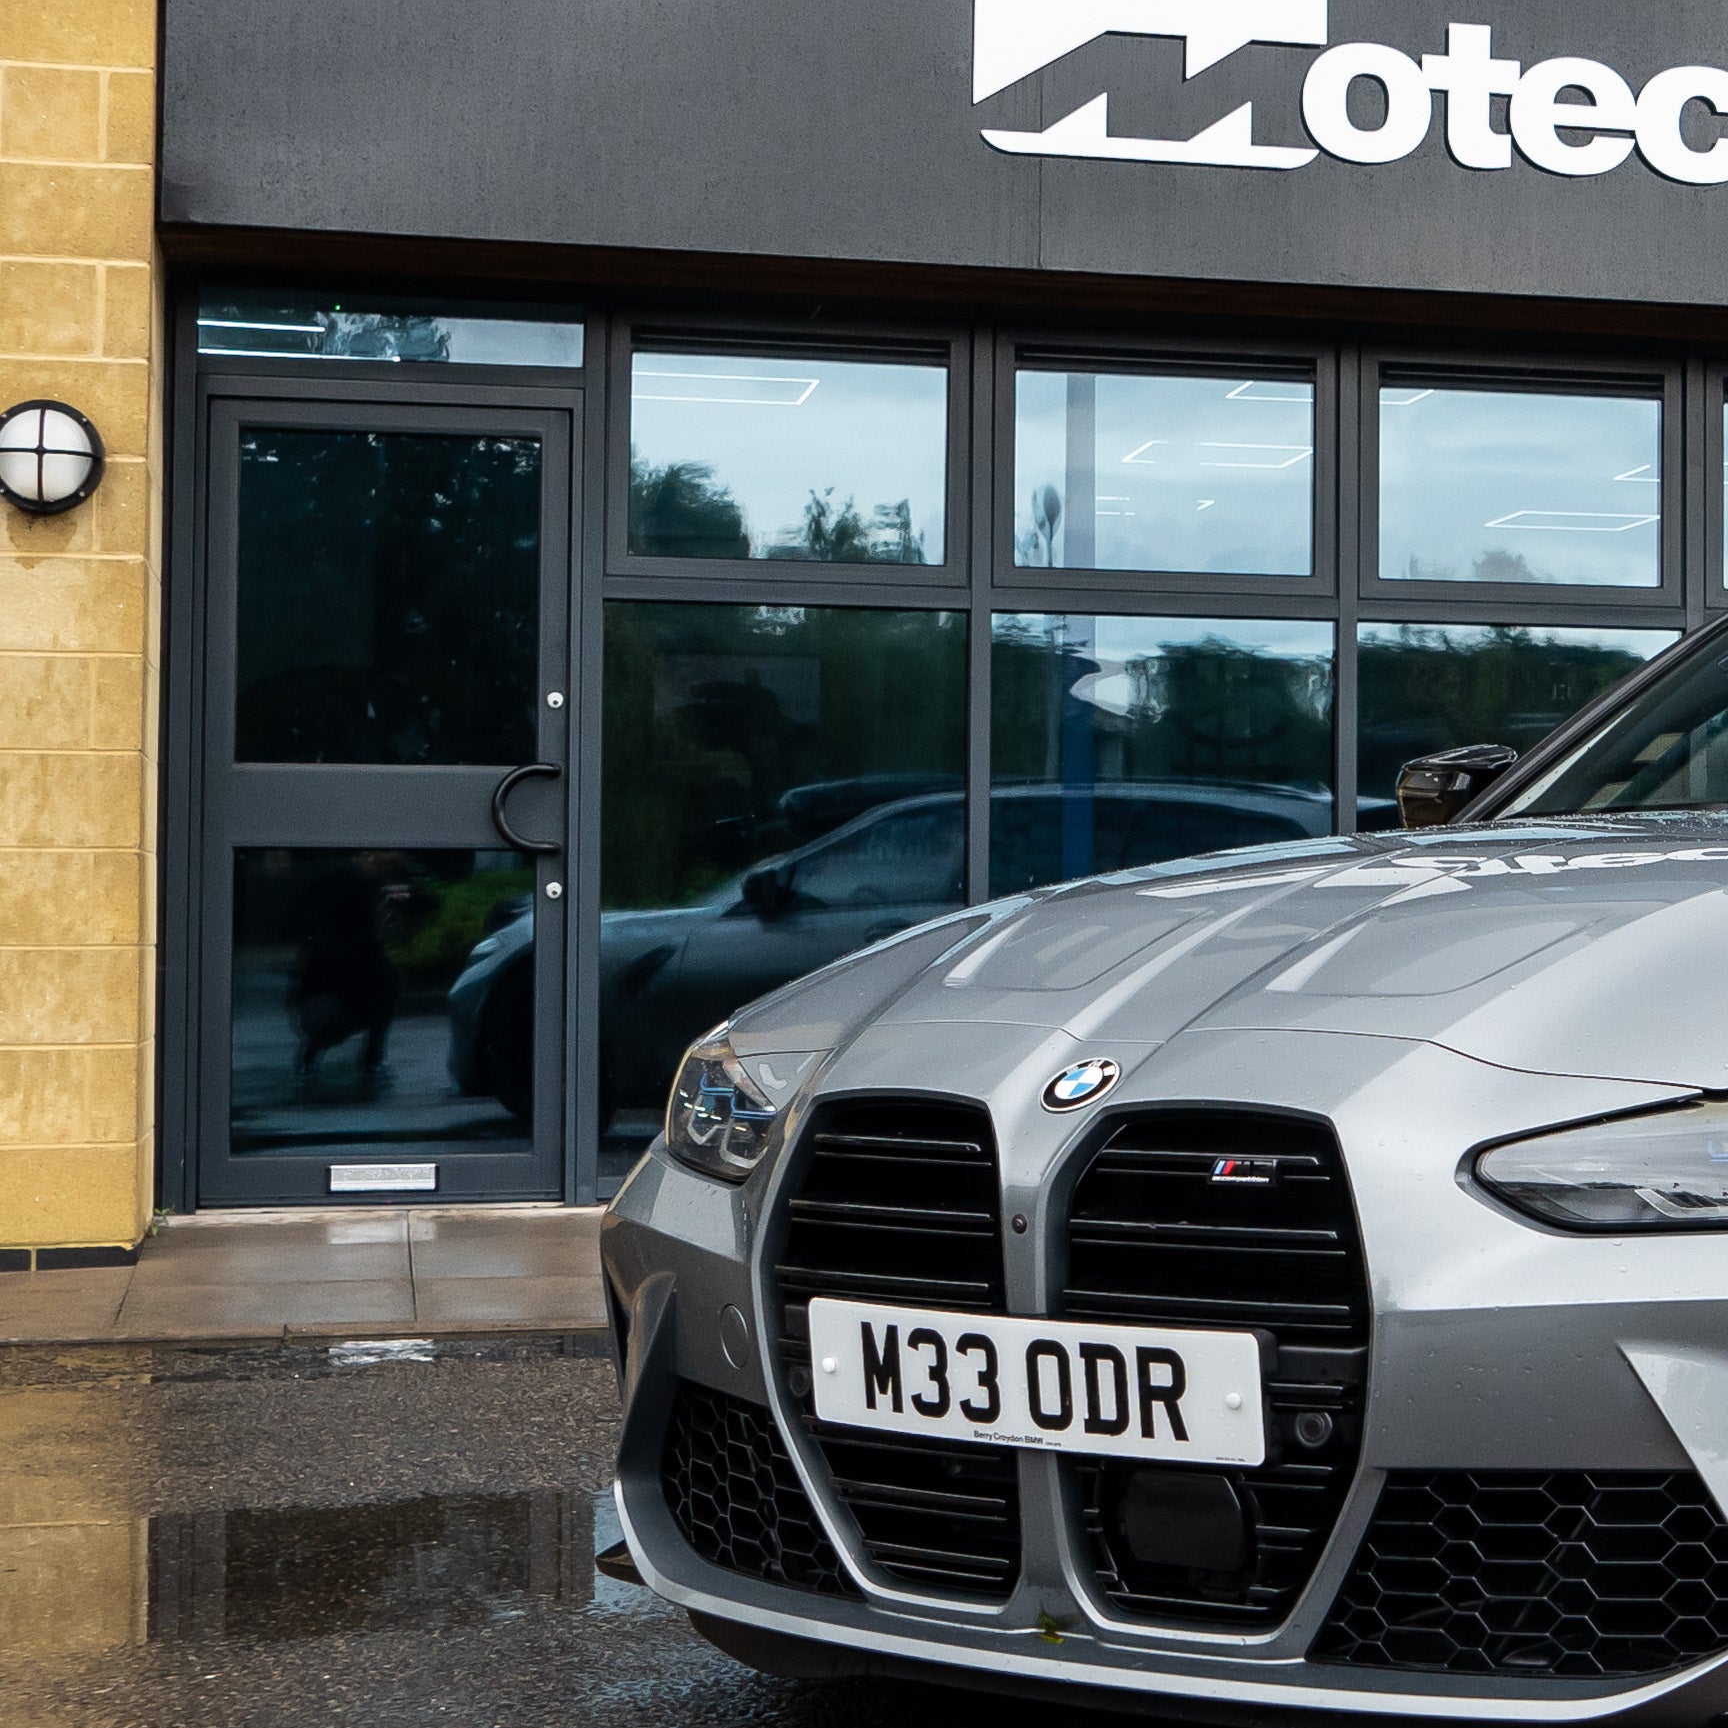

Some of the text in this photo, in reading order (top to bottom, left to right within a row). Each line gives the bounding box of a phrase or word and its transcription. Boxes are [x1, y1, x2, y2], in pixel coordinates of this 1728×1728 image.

[859, 1321, 1190, 1442] M33 ODR
[973, 1429, 993, 1441] Berry
